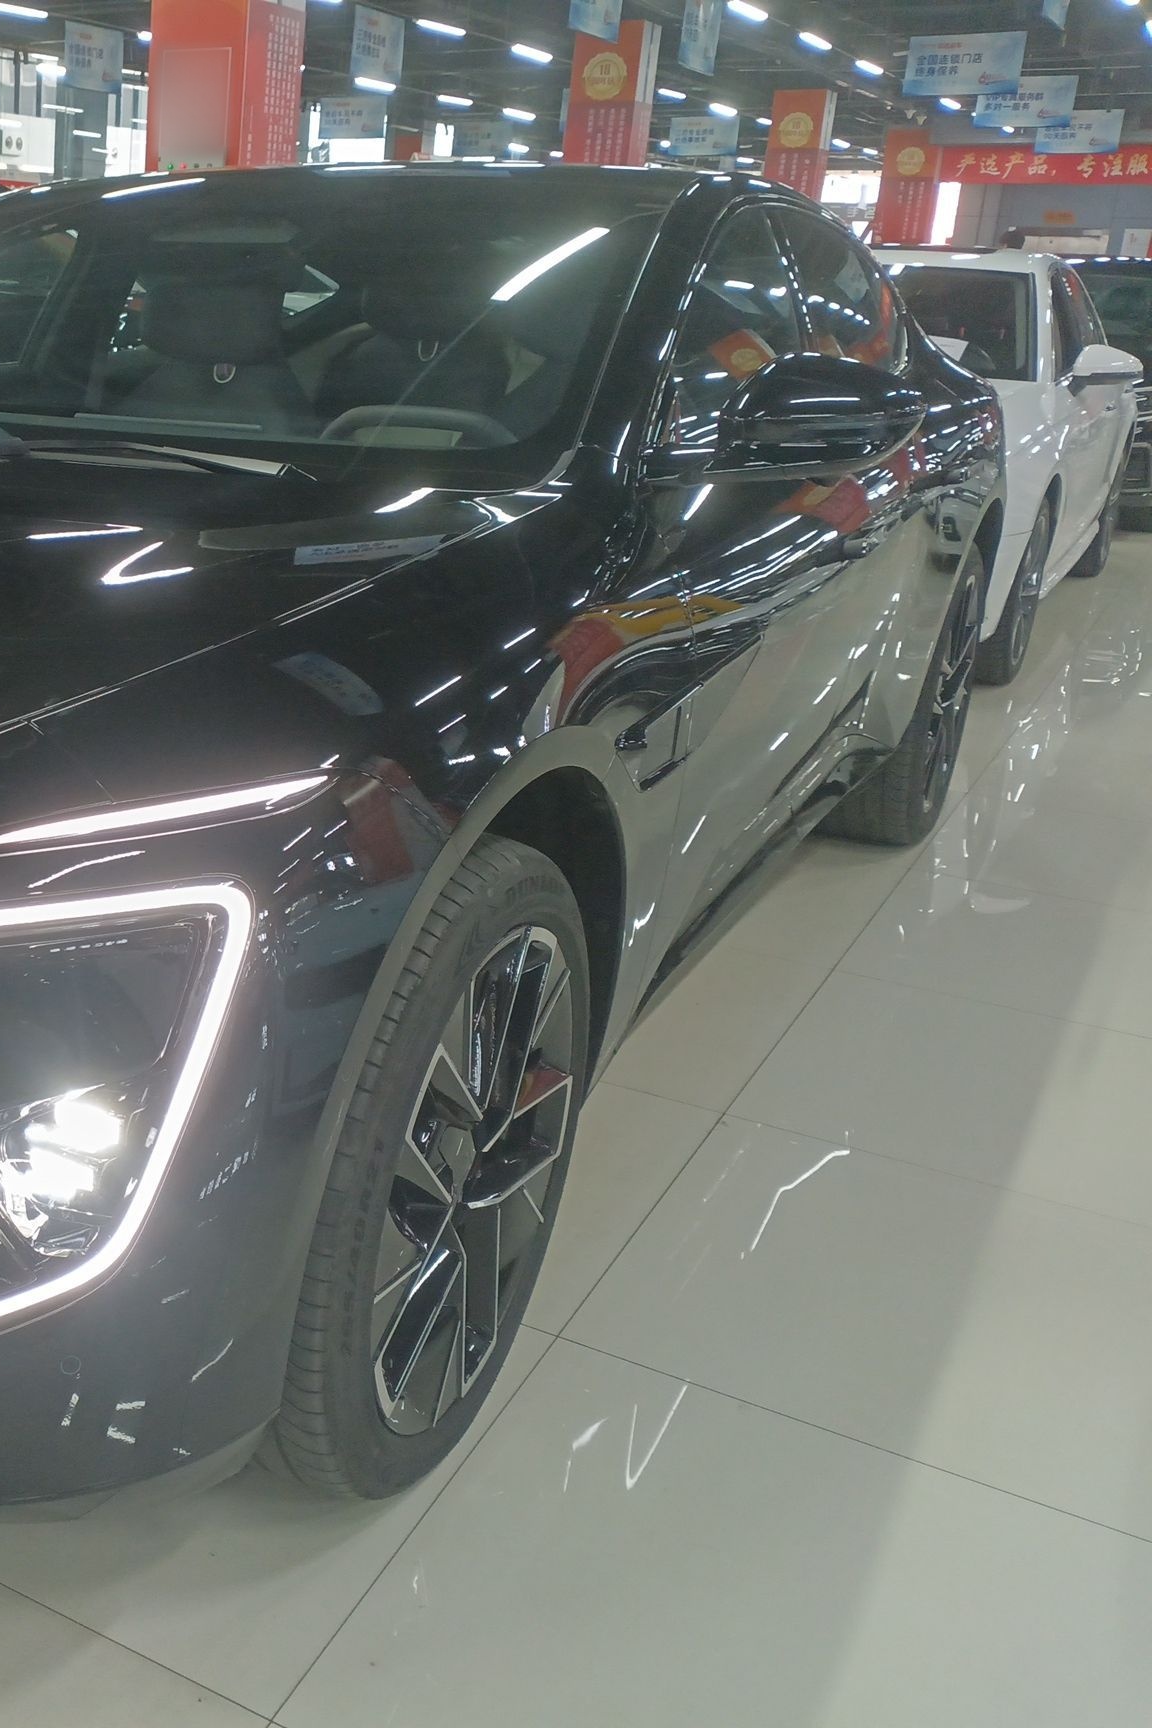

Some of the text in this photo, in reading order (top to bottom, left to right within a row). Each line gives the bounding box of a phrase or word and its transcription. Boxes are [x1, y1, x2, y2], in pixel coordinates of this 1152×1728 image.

[916, 53, 984, 66] 全国连锁门店
